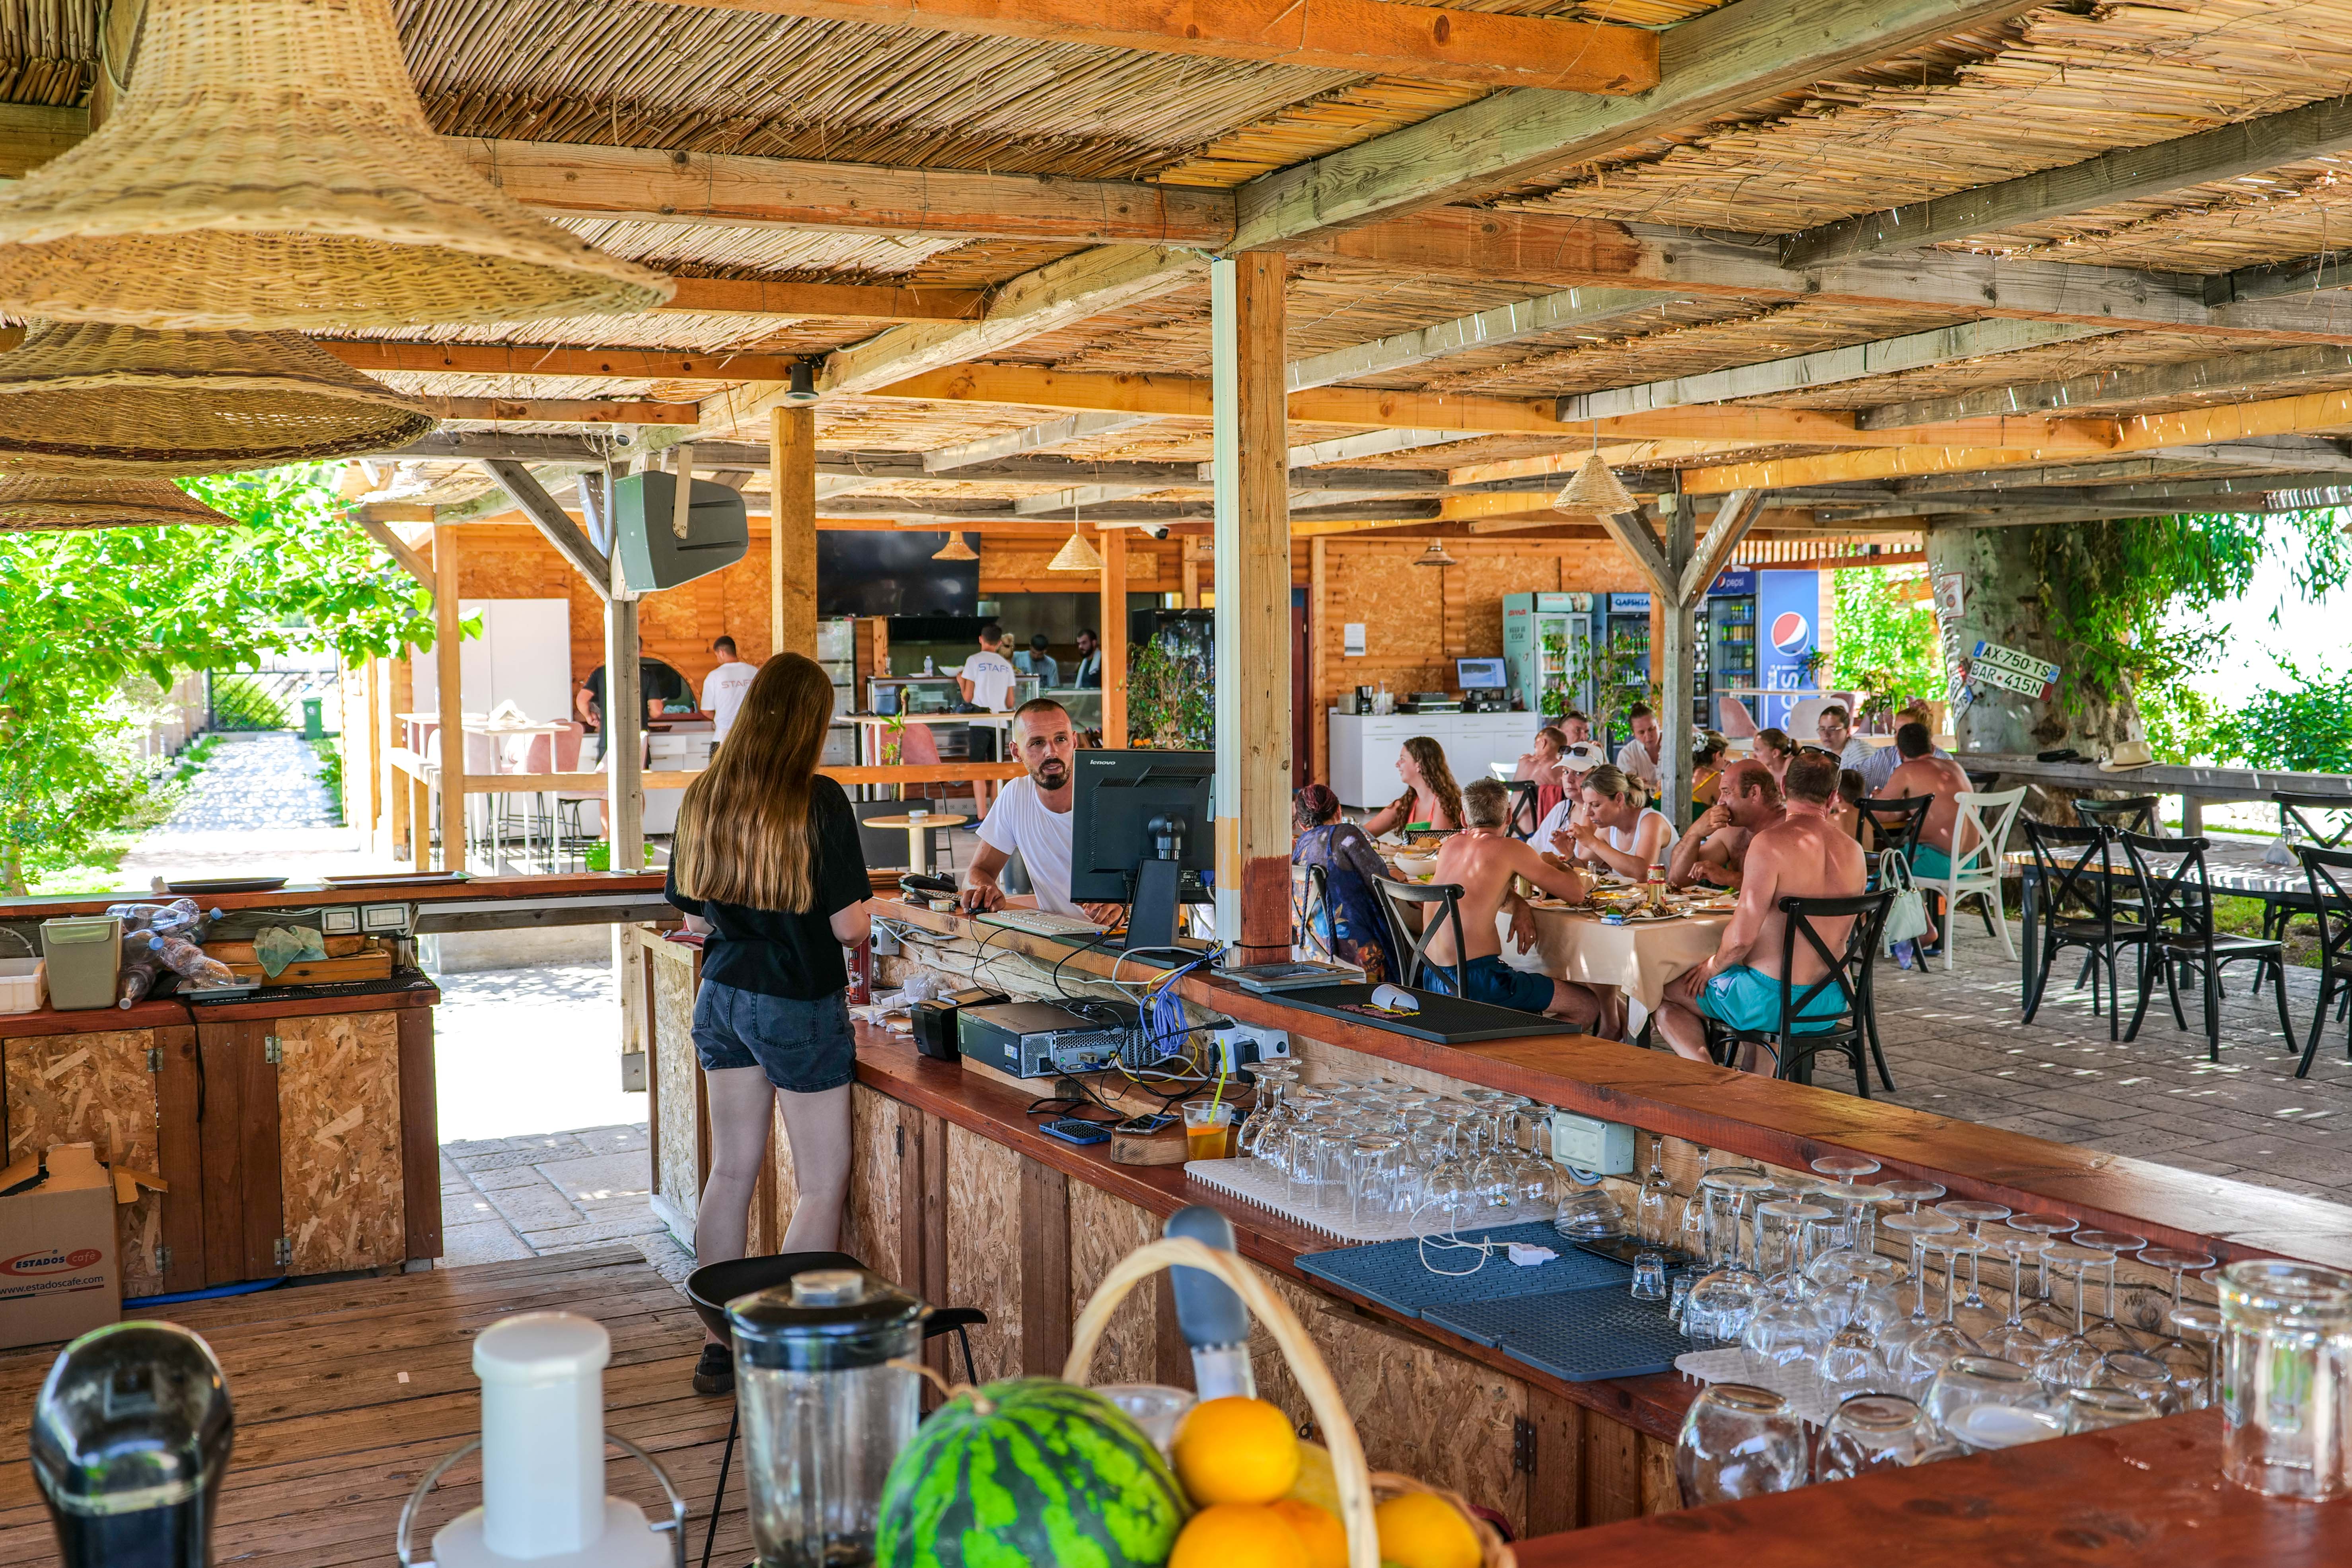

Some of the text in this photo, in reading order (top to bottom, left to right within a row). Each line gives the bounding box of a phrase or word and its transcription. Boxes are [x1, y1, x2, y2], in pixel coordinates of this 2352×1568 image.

[1726, 577, 1744, 588] pepsi
[1615, 598, 1649, 606] QAFSHTA
[1971, 663, 2044, 696] BAR 415N
[16, 1256, 65, 1268] ESTADOS
[0, 1276, 103, 1294] www.estadoscafe.com
